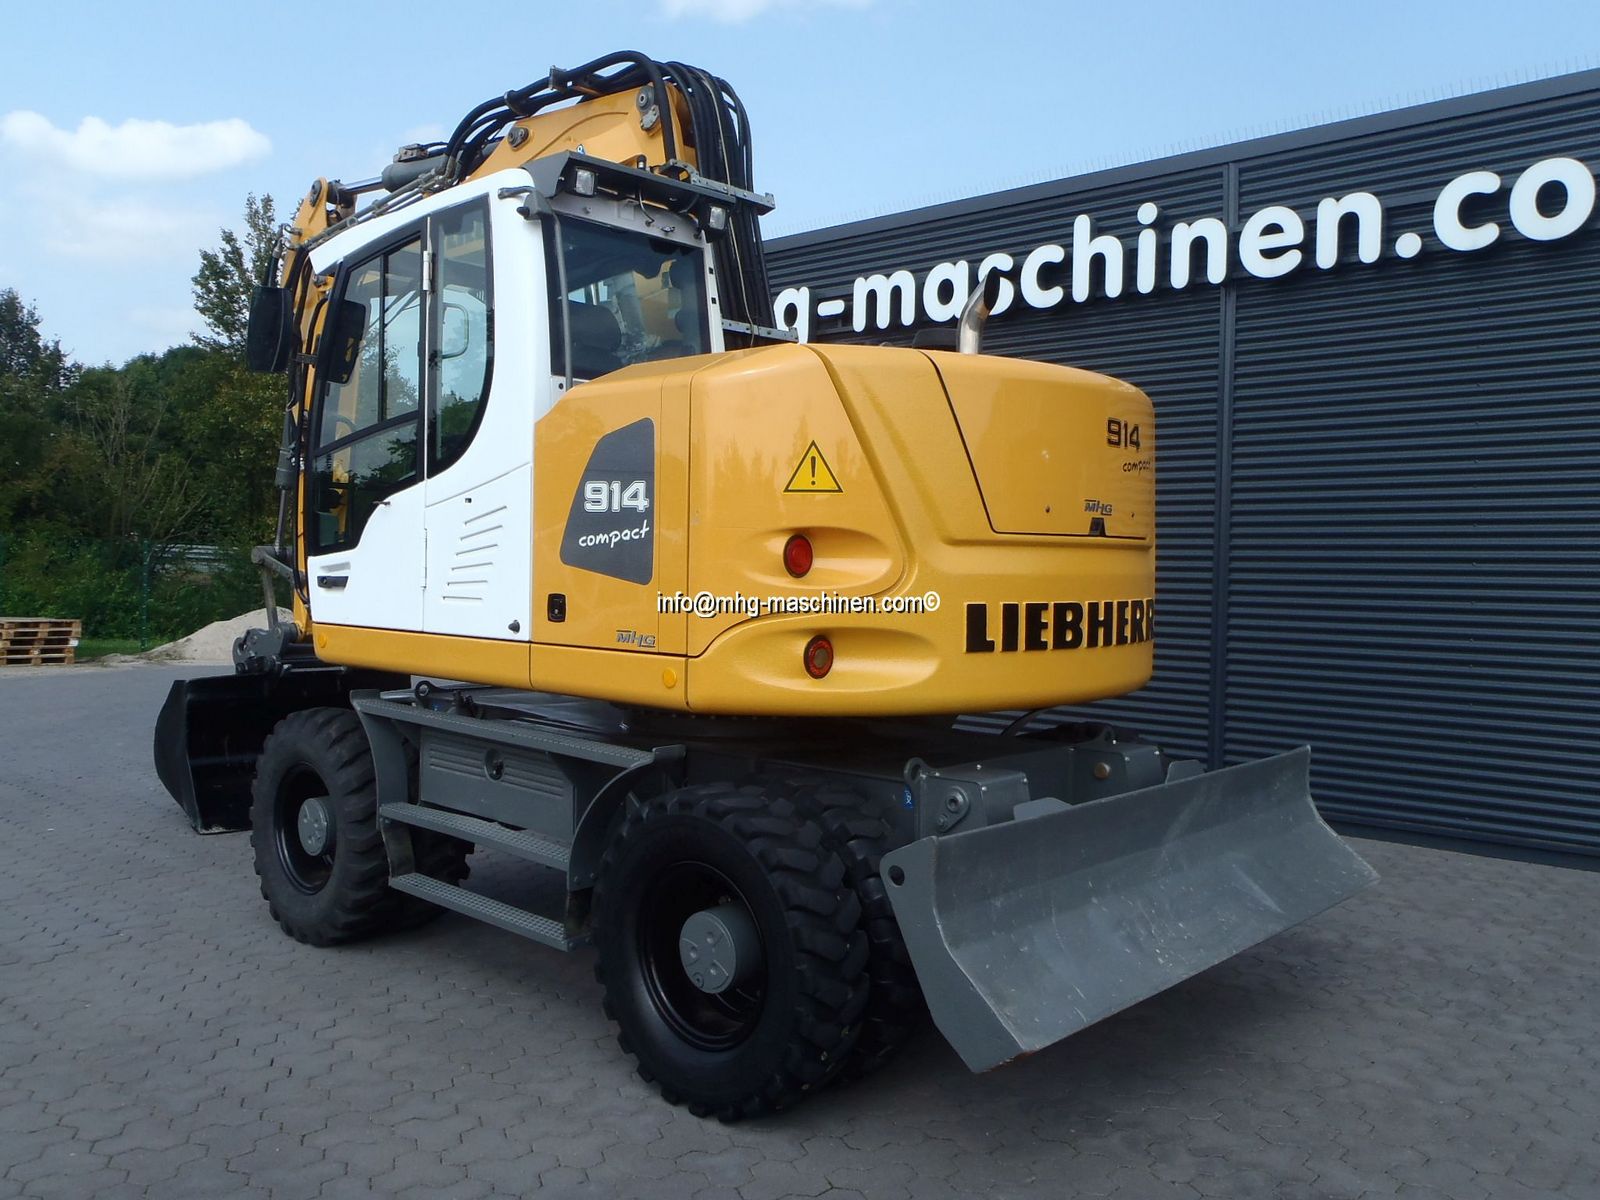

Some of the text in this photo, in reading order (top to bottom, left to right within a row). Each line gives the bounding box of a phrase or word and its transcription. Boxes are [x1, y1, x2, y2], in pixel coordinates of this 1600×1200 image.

[1106, 418, 1140, 453] 914
[584, 480, 649, 513] 914
[1084, 499, 1113, 516] MHG
[579, 519, 650, 548] compact
[616, 629, 656, 649] MHG
